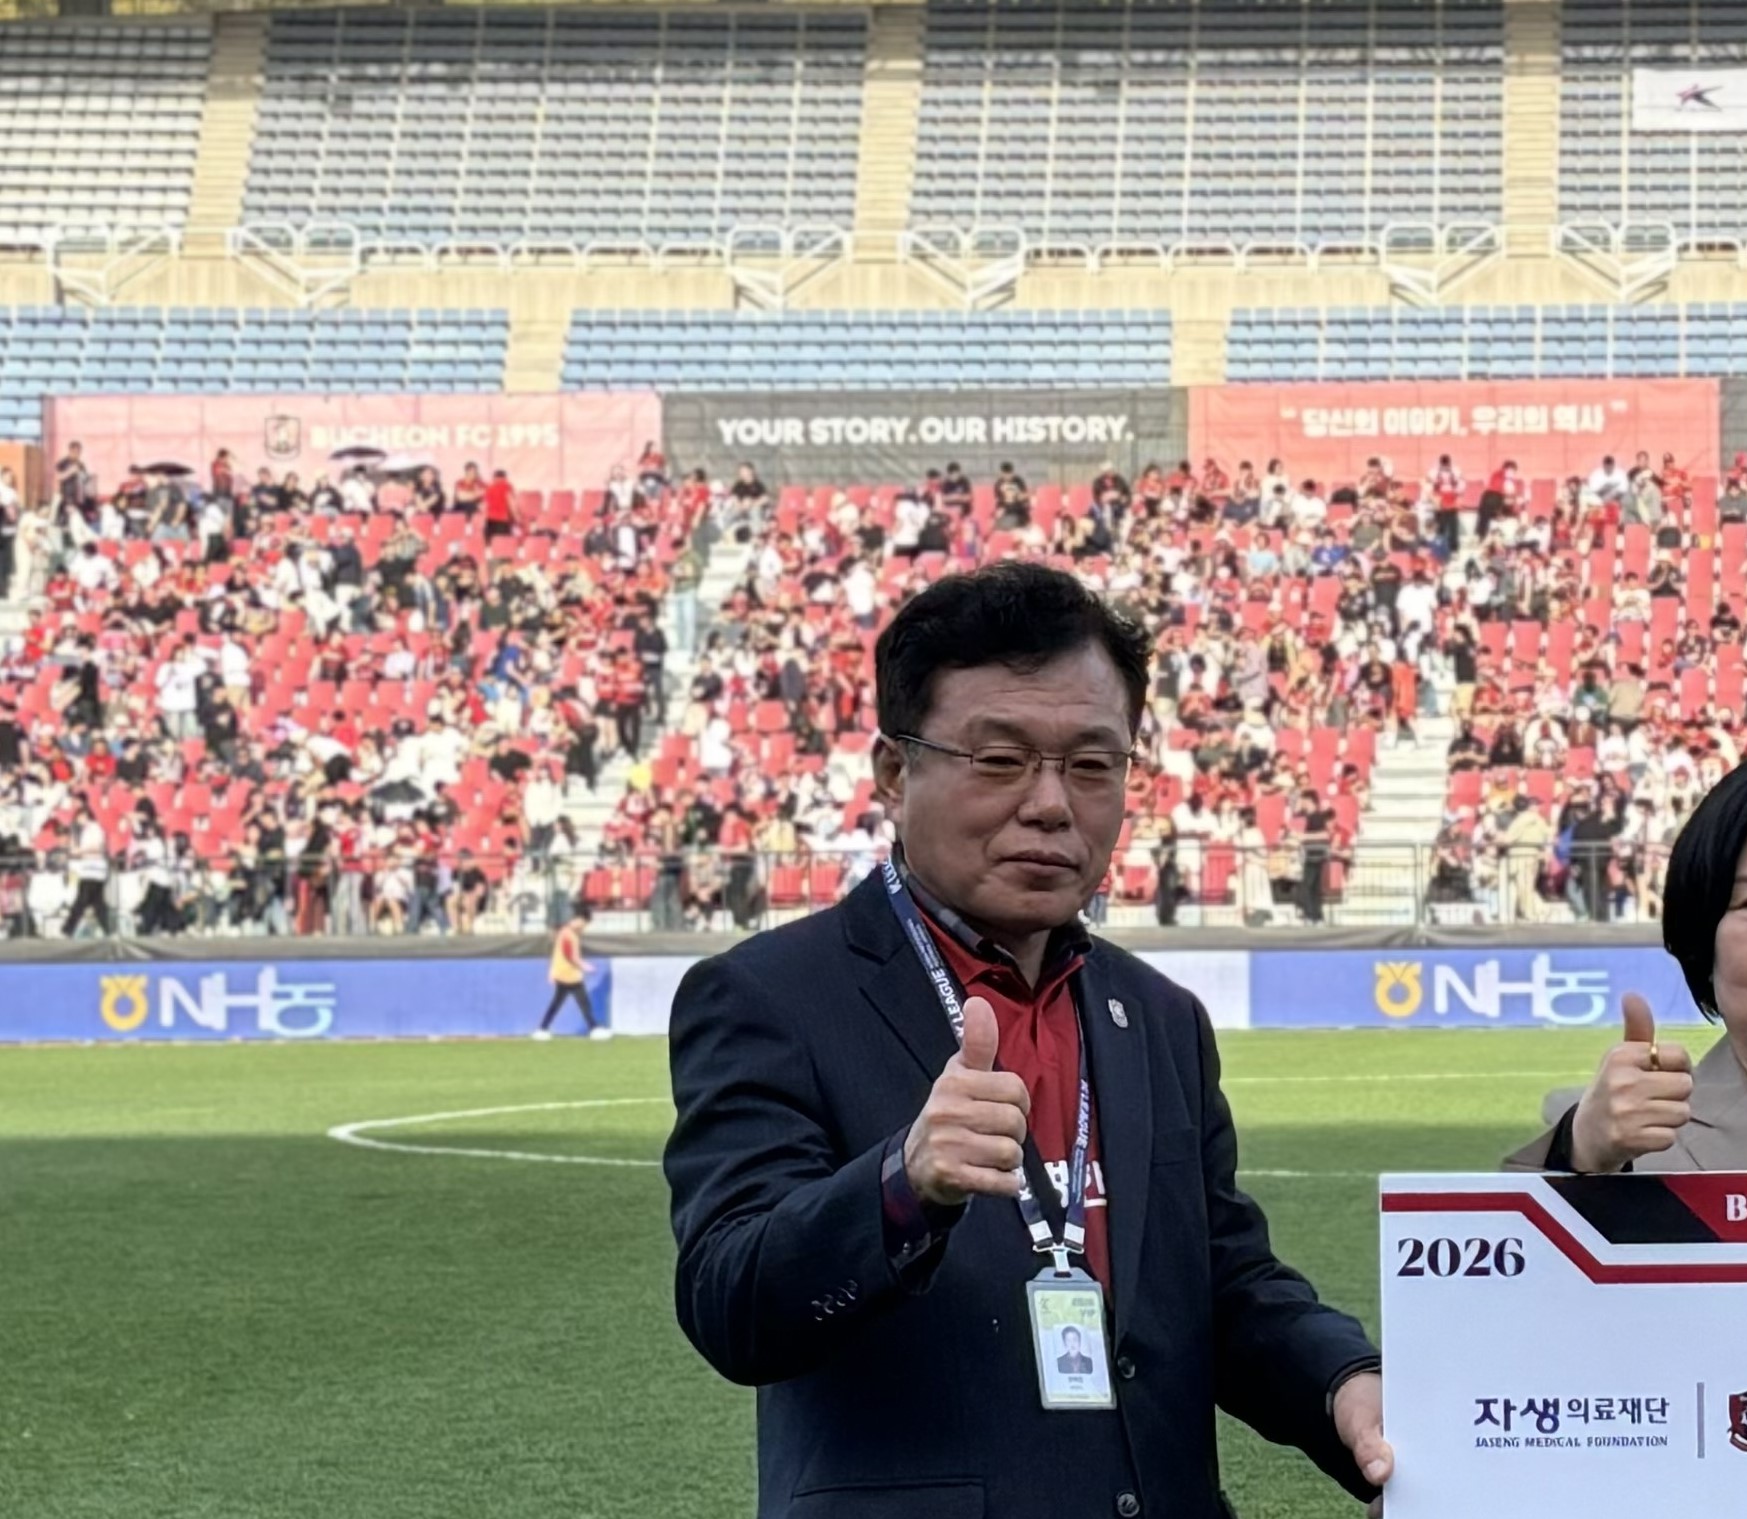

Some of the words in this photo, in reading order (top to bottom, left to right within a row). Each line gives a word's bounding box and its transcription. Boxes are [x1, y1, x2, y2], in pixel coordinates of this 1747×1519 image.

[717, 417, 804, 445] YOUR
[993, 415, 1135, 442] HISTORY.
[1471, 405, 1549, 435] 우리의
[309, 424, 448, 448] BUCHEON
[456, 423, 491, 448] FC
[496, 423, 559, 448] 1995
[931, 968, 965, 1024] LEAGUE
[1396, 1237, 1526, 1278] 2026
[1474, 1435, 1520, 1449] JASENG
[1524, 1435, 1581, 1448] MEDICAL
[1586, 1434, 1669, 1447] FOUNDATION
